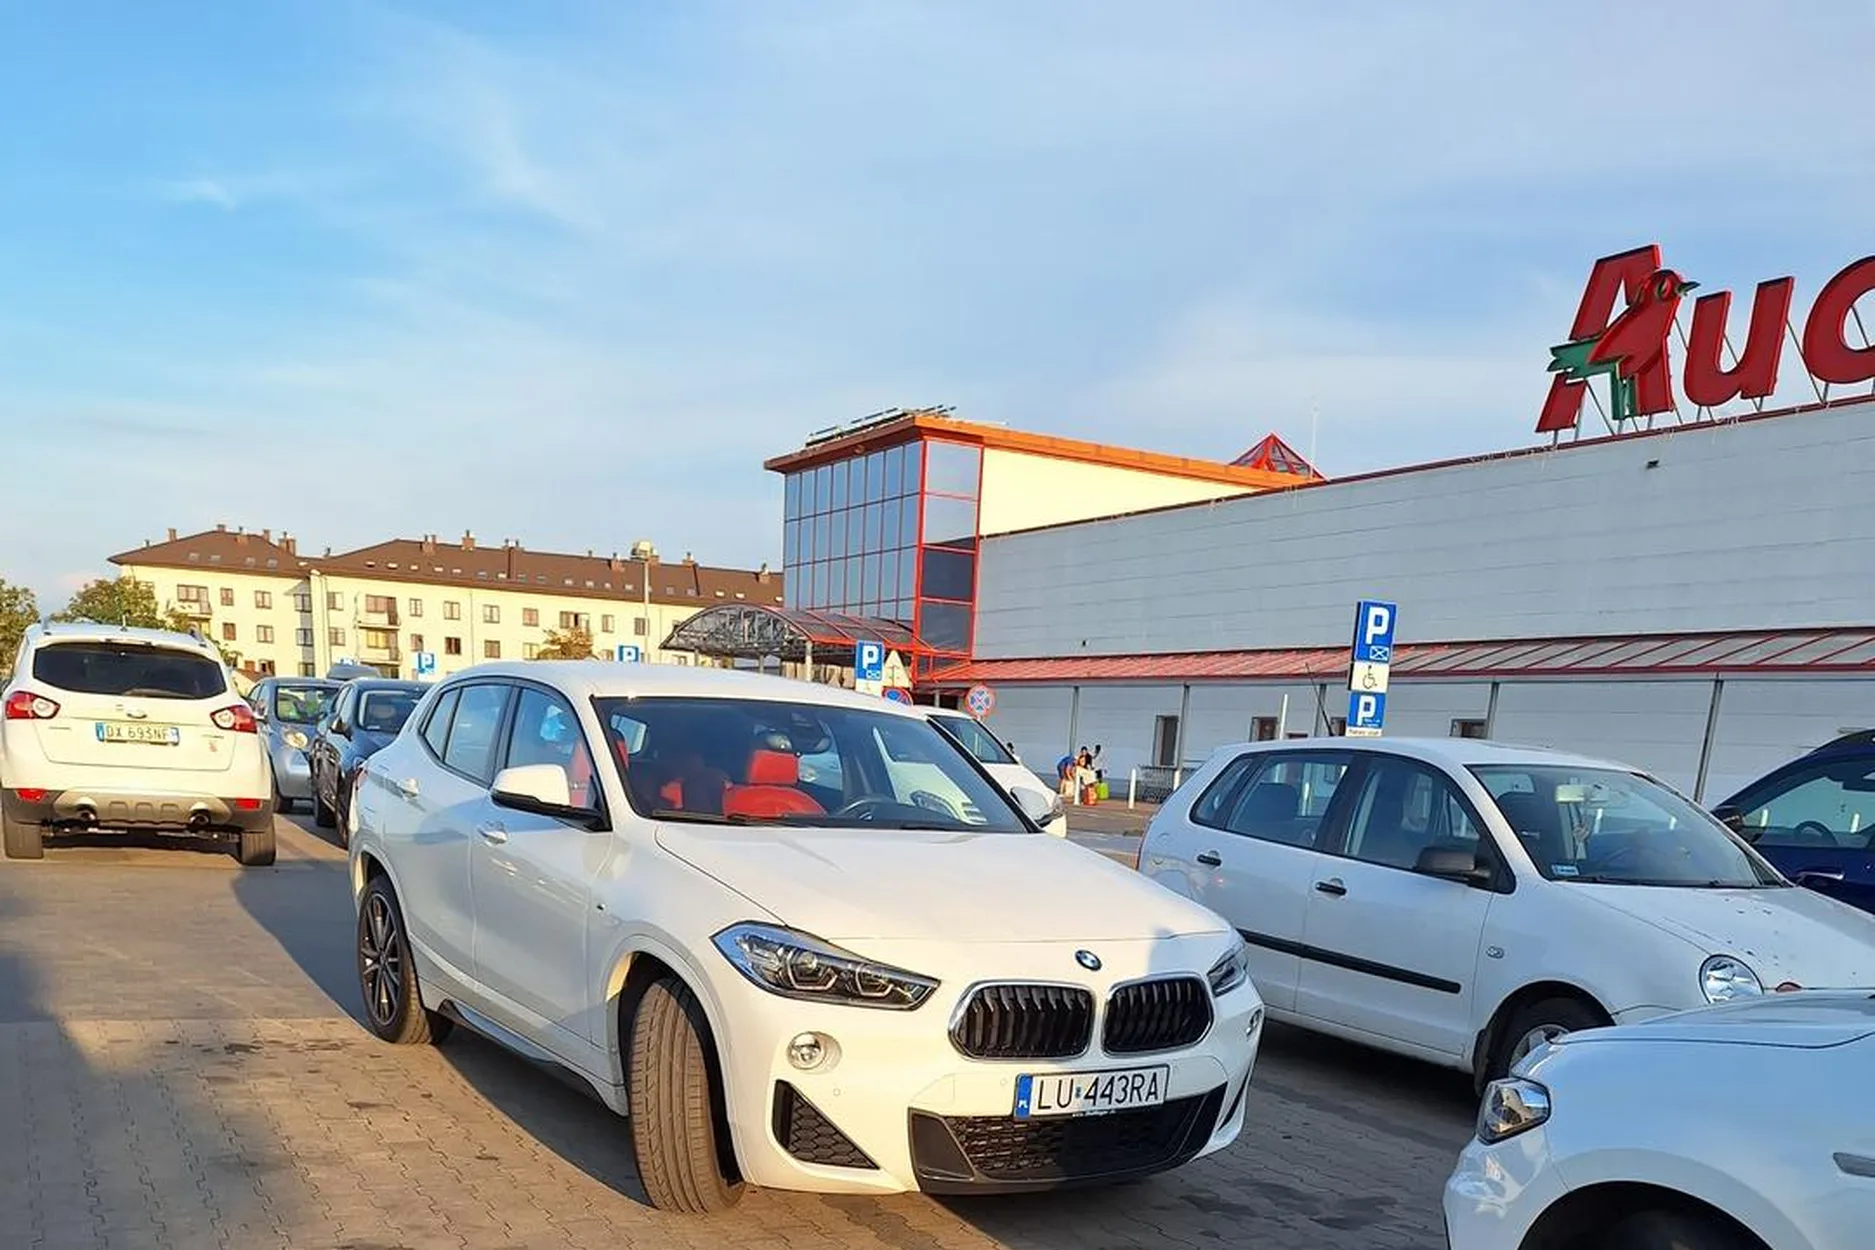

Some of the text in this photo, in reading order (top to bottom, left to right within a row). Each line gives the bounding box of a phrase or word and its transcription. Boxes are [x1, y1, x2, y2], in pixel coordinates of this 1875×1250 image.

[1365, 605, 1390, 645] P
[862, 645, 879, 670] P
[1357, 694, 1377, 726] P
[1037, 1071, 1159, 1110] LU 443RA
